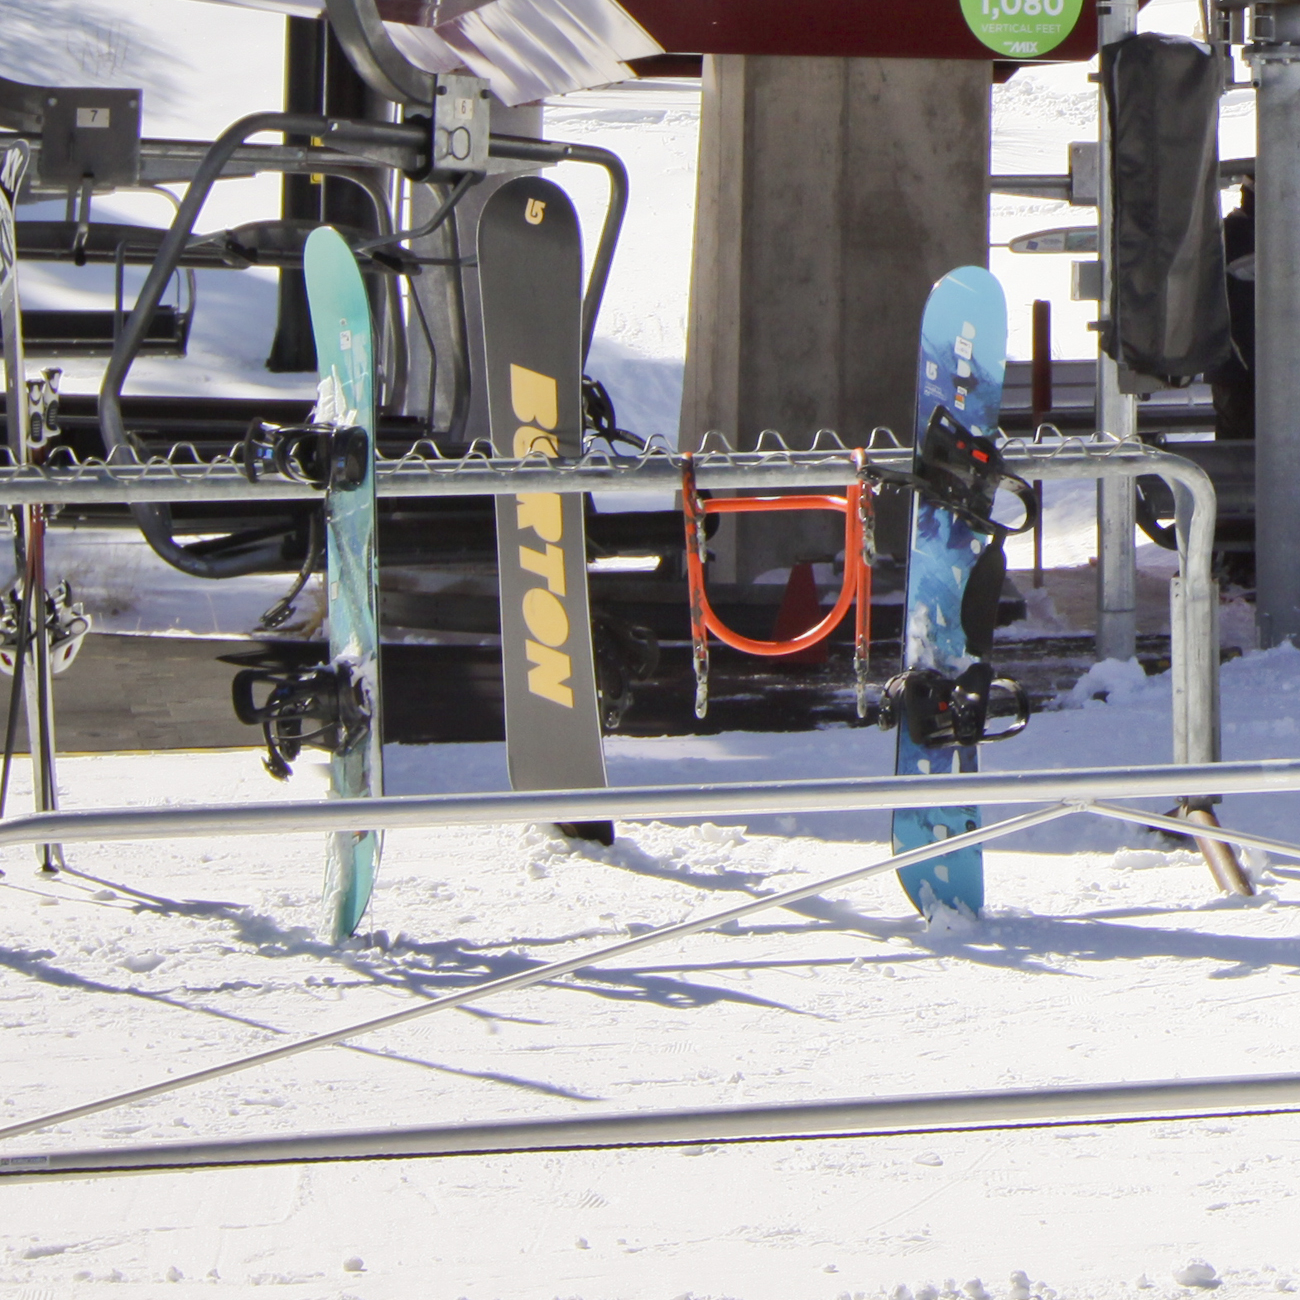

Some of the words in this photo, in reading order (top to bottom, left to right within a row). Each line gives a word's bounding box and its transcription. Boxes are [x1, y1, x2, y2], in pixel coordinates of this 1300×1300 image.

[981, 23, 1032, 33] VERTICAL
[1036, 23, 1061, 34] FEET
[90, 110, 98, 122] 7
